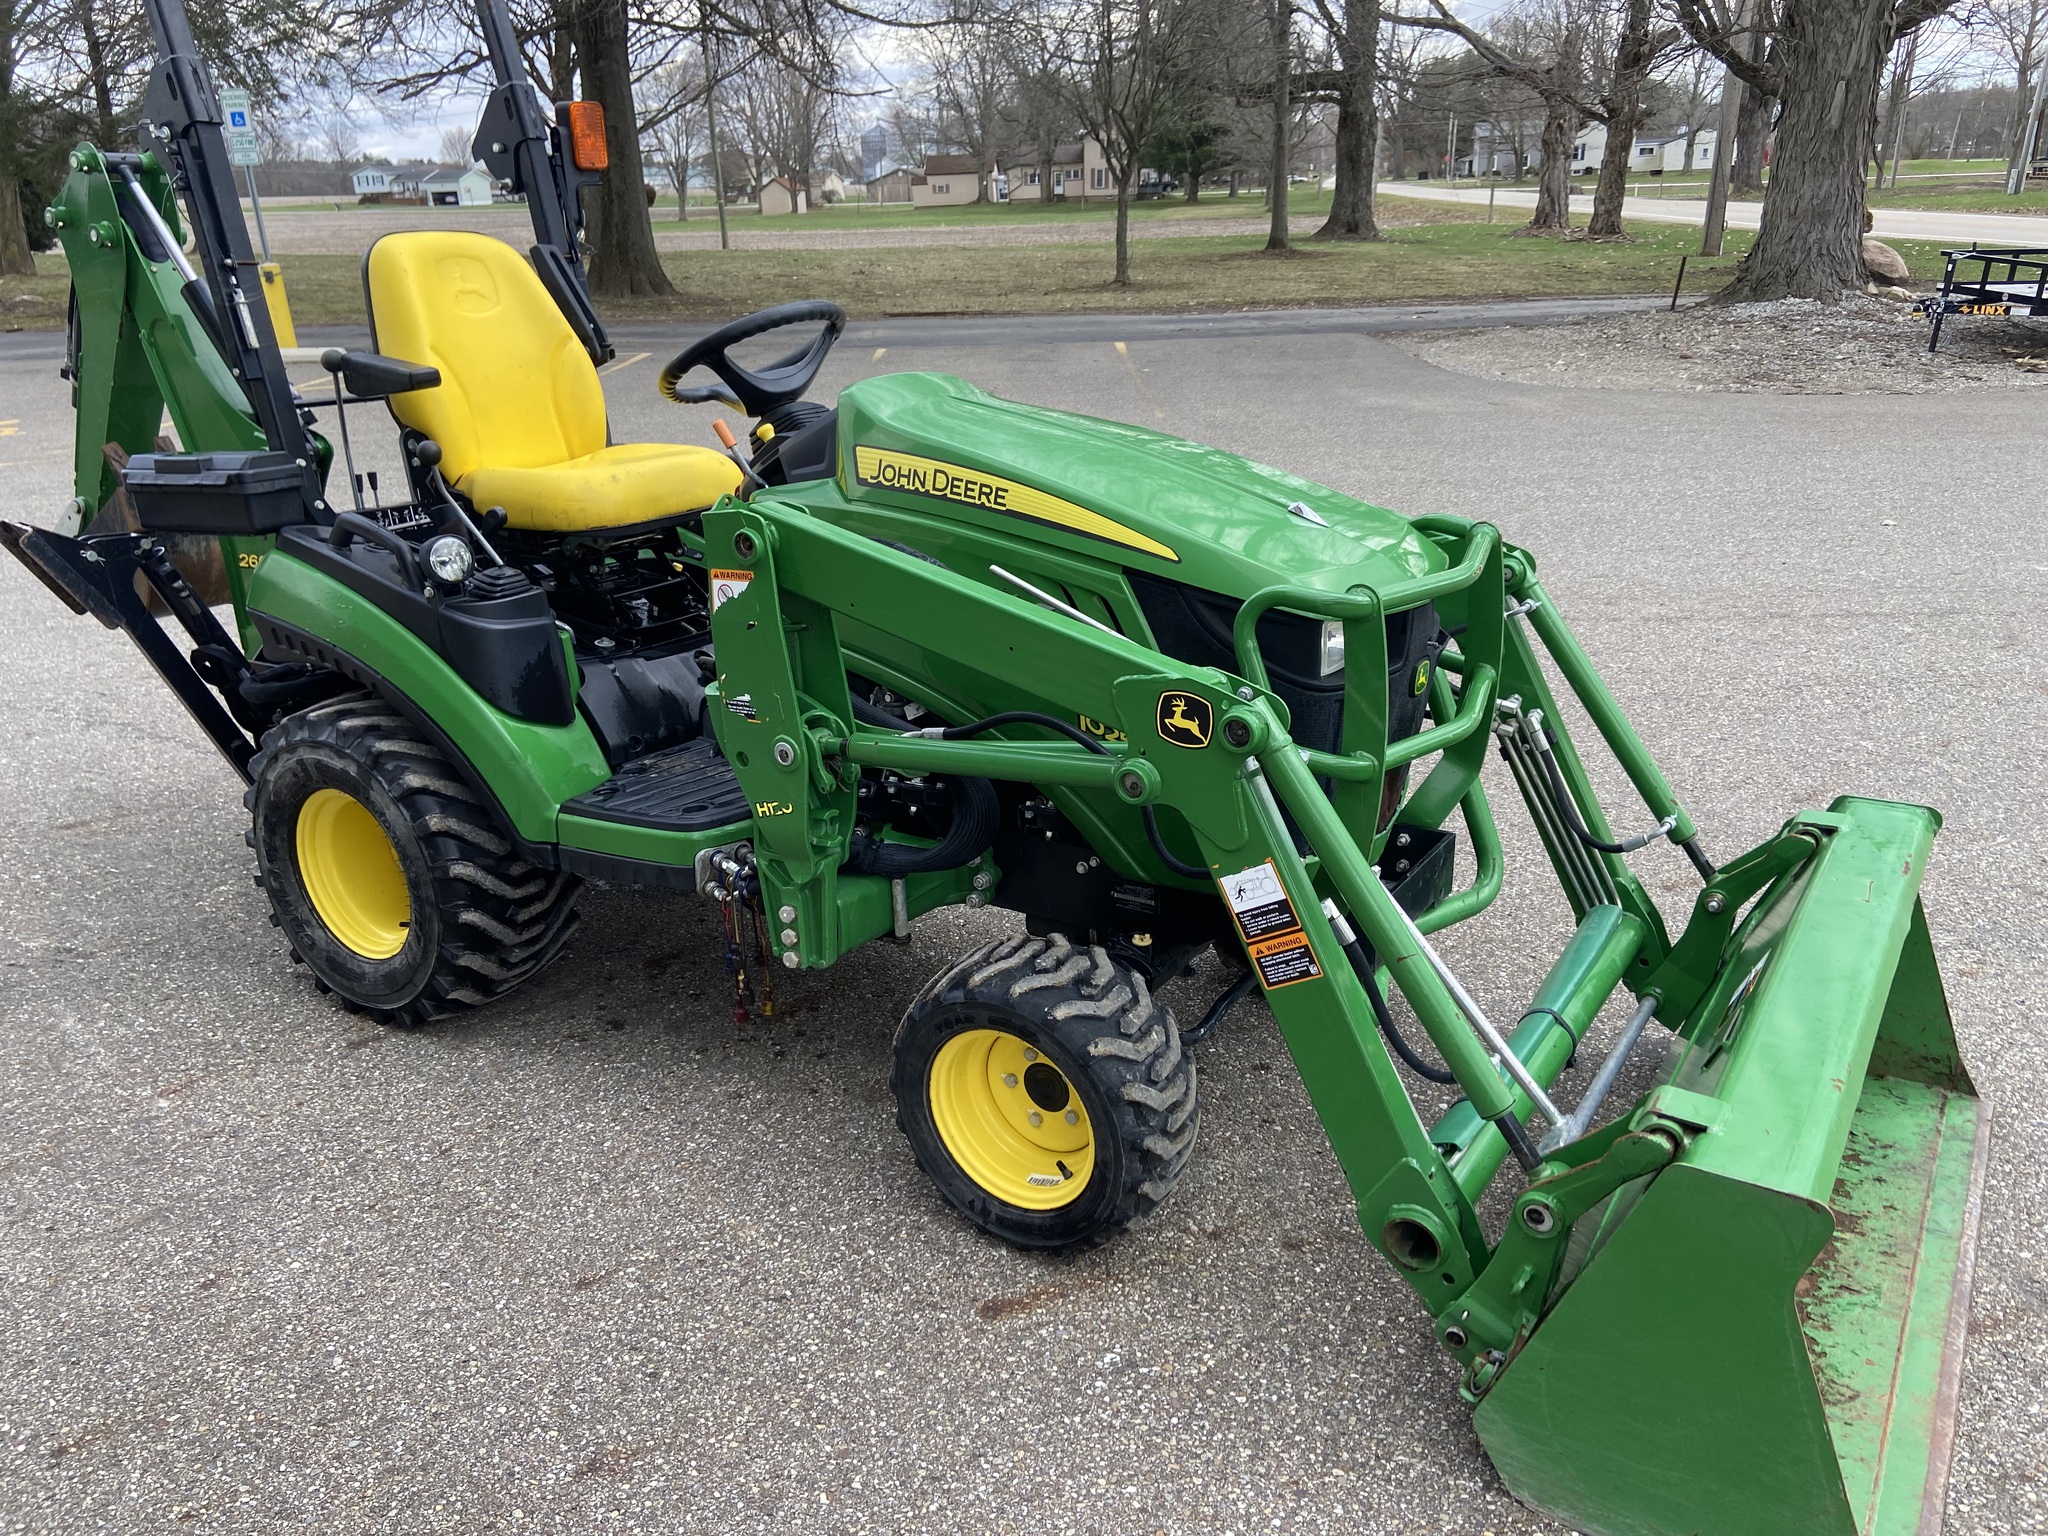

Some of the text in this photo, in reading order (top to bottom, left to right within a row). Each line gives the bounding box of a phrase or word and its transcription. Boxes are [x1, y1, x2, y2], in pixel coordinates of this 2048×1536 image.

[1973, 305, 2006, 315] LINX
[870, 459, 1009, 508] JOHN DEERE
[719, 571, 753, 580] WARNING
[1265, 936, 1302, 952] WARNING
